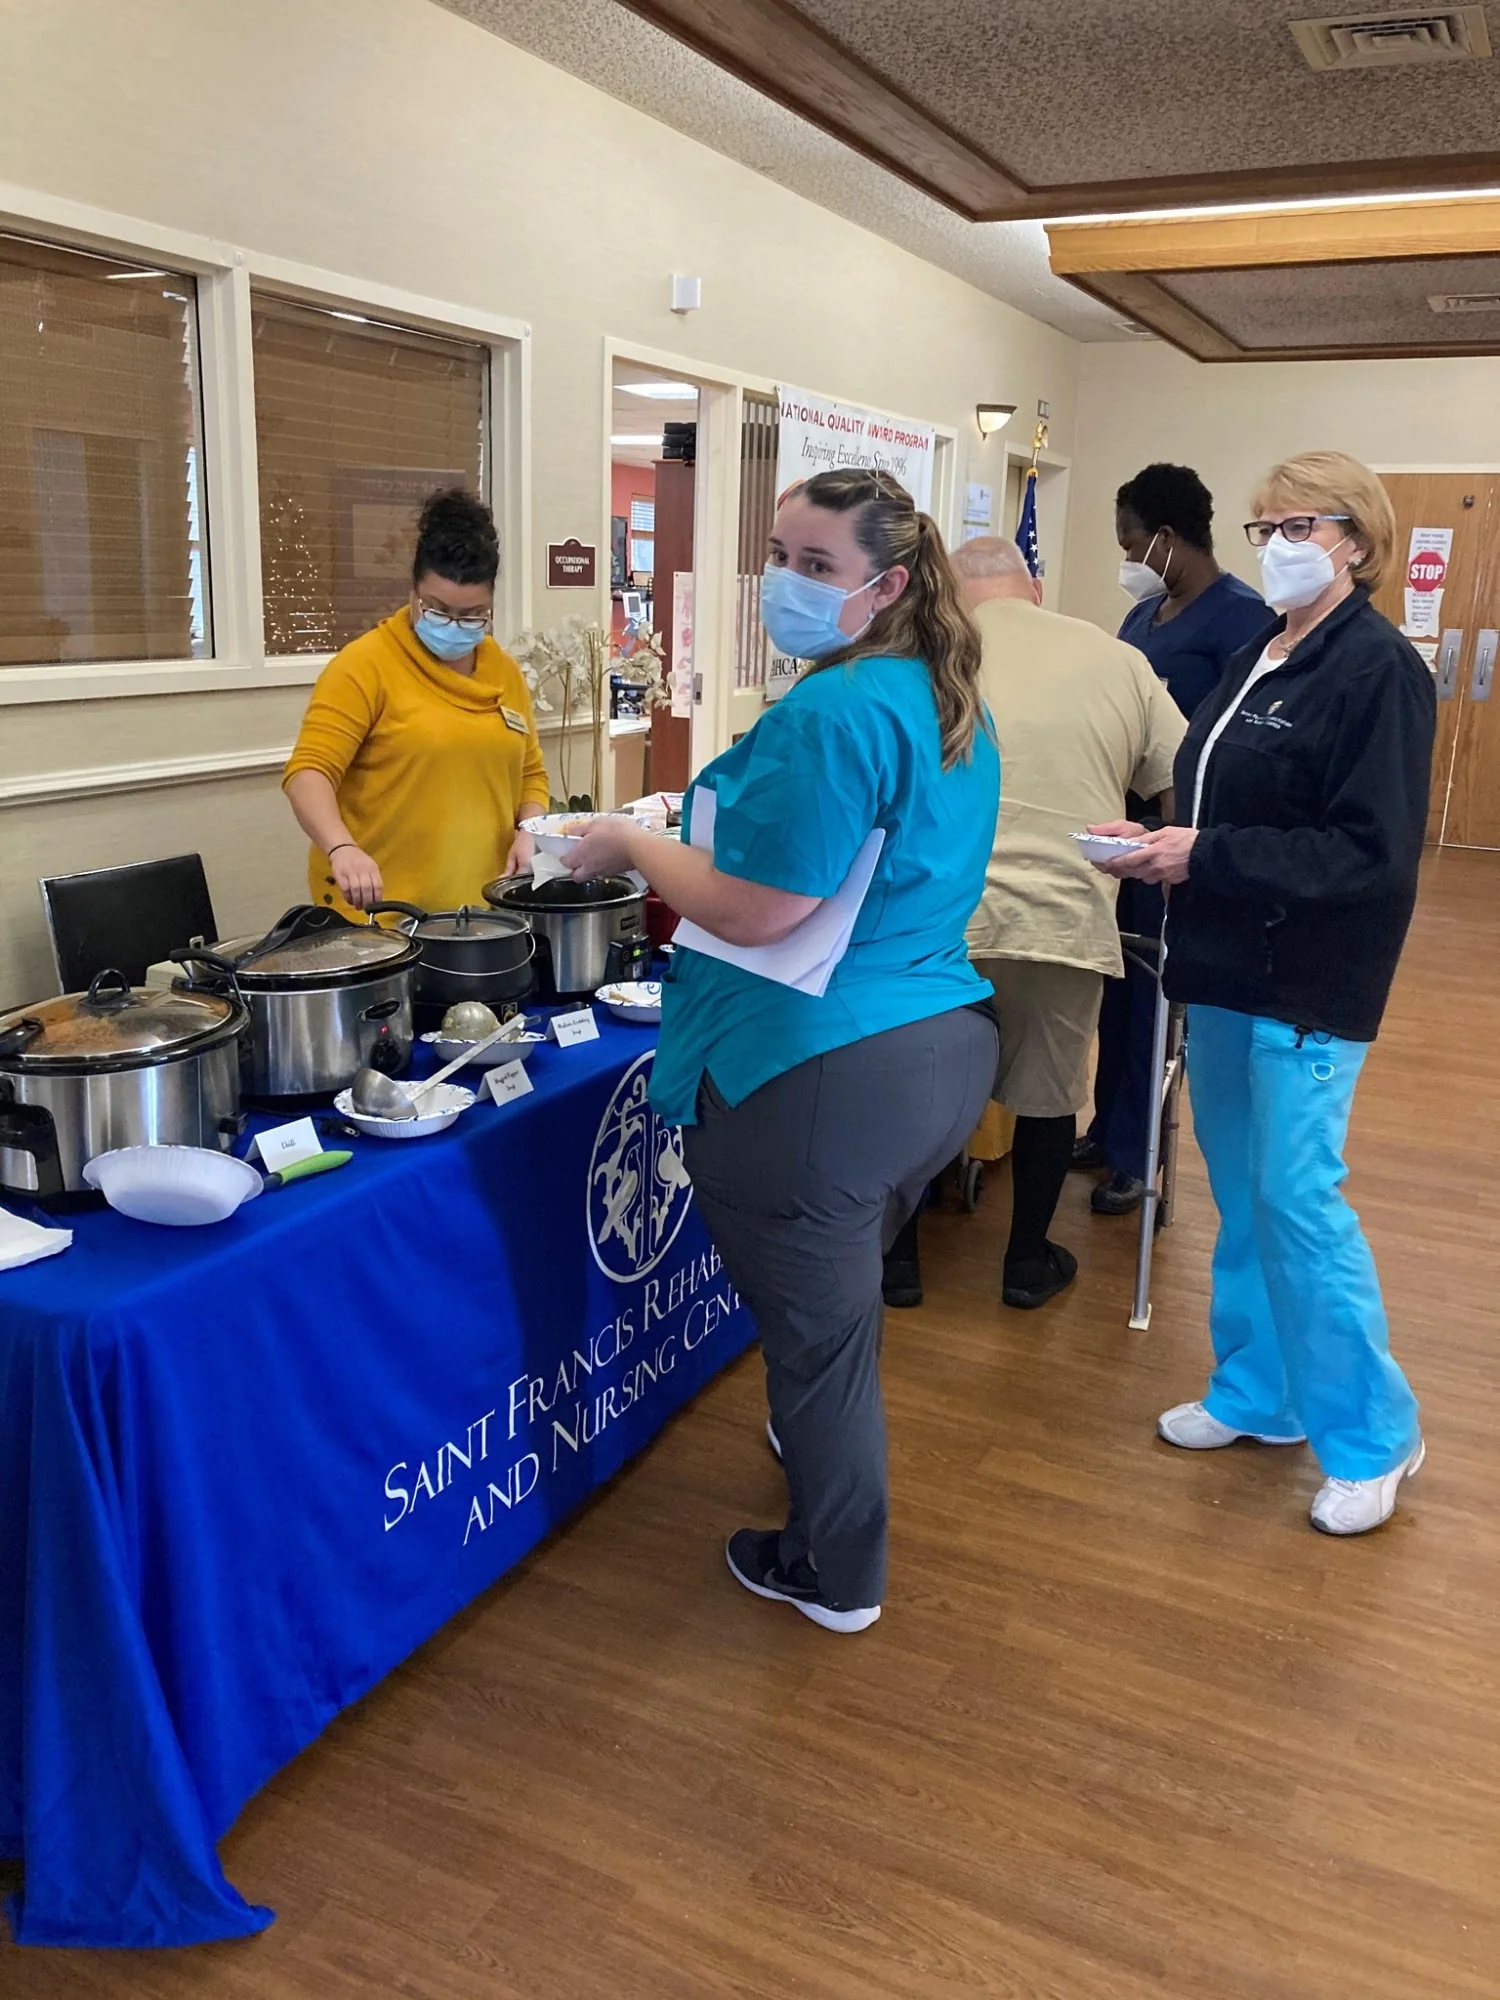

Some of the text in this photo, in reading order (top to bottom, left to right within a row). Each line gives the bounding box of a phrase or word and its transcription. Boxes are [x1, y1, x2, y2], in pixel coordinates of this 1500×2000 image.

[827, 414, 865, 436] QUALITY
[801, 436, 836, 469] Inspiring
[555, 556, 590, 565] OCCUPATIONAL
[562, 564, 583, 573] THERAPY
[1410, 563, 1443, 580] STOP
[383, 1244, 724, 1532] SAINT FRANCIS REHAB
[462, 1452, 540, 1546] AND
[550, 1335, 677, 1473] NURSING
